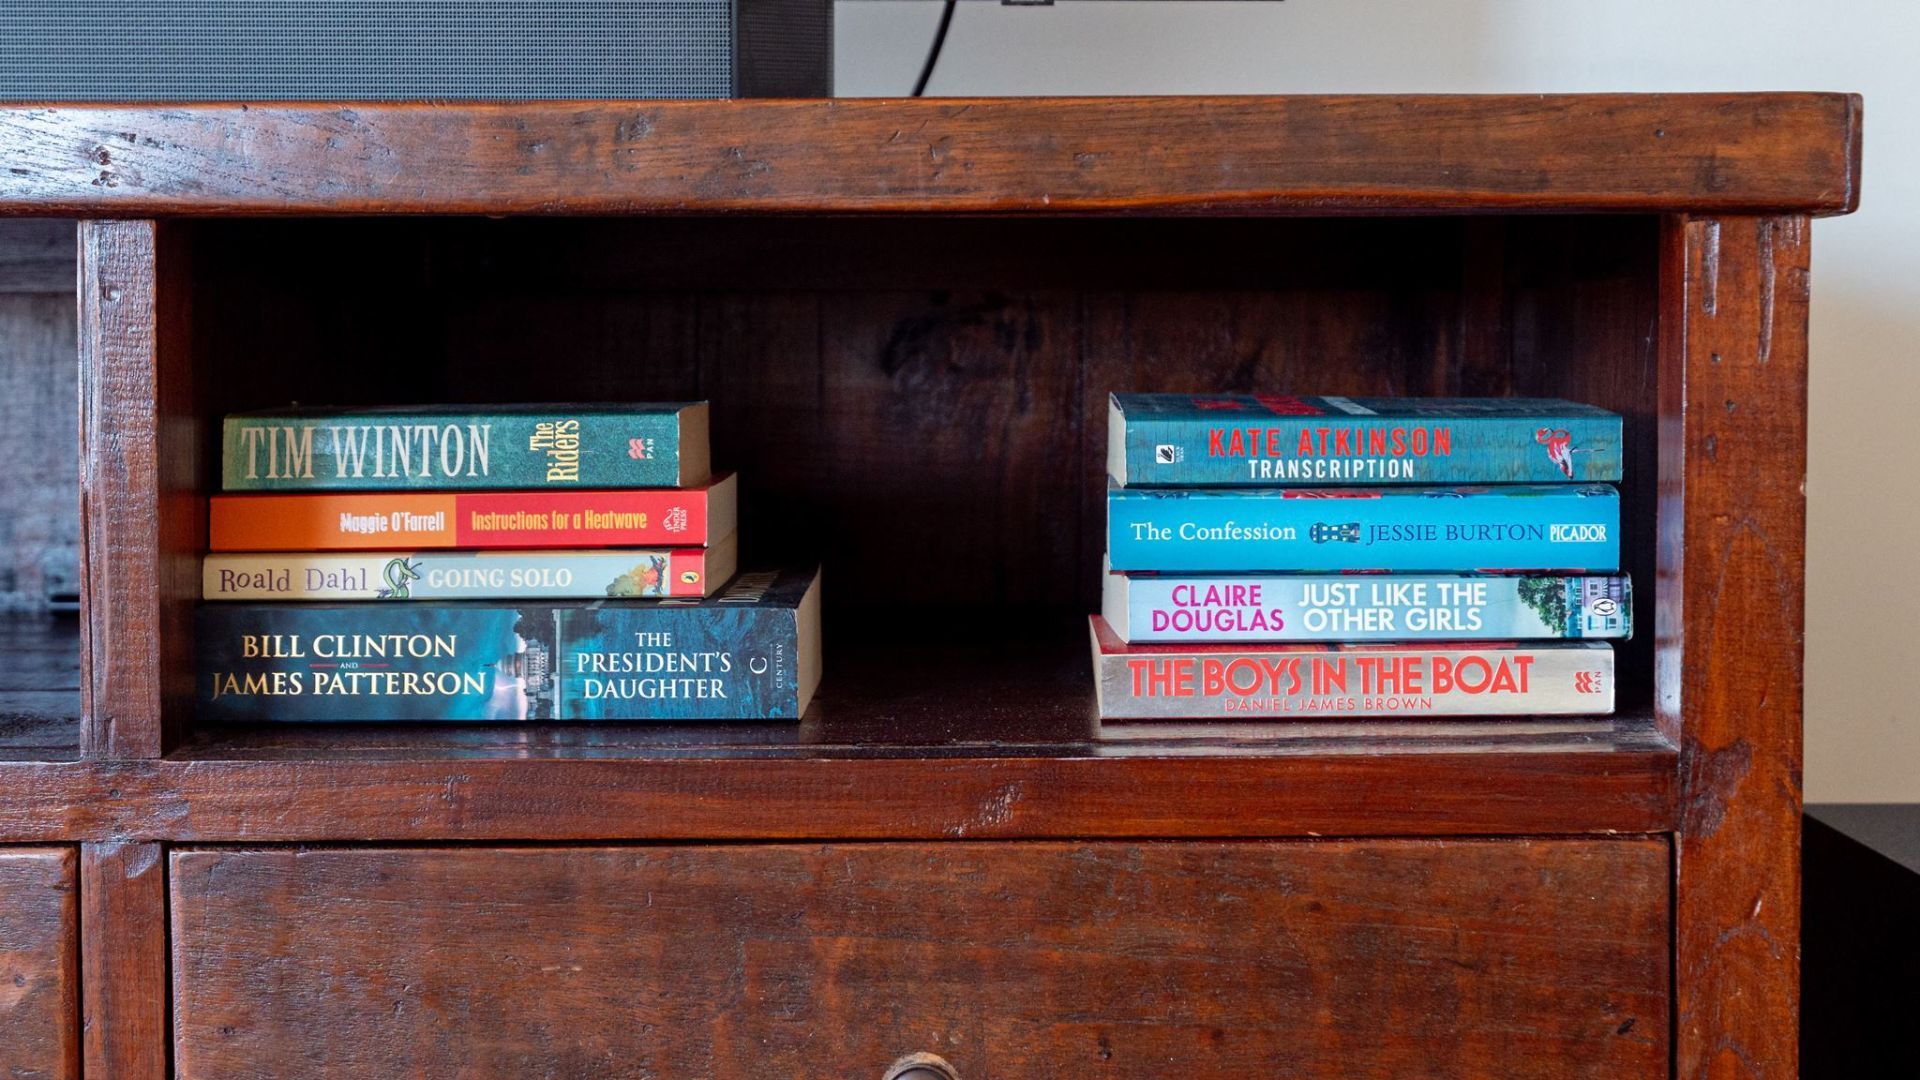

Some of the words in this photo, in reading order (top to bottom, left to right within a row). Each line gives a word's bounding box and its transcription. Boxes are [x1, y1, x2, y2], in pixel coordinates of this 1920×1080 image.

[529, 422, 554, 451] The
[1208, 428, 1281, 457] KATE
[1297, 427, 1451, 457] ATKINSON
[241, 426, 316, 479] TIM
[329, 424, 491, 478] WINTON
[547, 420, 580, 482] Riders
[646, 439, 654, 459] PAN
[1248, 459, 1414, 479] TRANSCRIPTION
[340, 512, 387, 534] Maggie
[471, 511, 548, 531] Instructions
[552, 510, 569, 529] for
[573, 513, 581, 529] a
[585, 509, 647, 529] Heatwave
[1130, 522, 1172, 541] The
[1179, 520, 1297, 541] Confession
[1366, 524, 1437, 545] JESSIE
[1445, 524, 1545, 542] BURTON
[1550, 523, 1607, 542] PICADOR
[219, 568, 291, 593] Roald
[304, 568, 368, 592] Dahl
[427, 568, 504, 588] GOING
[510, 567, 573, 588] SOLO
[1171, 584, 1262, 607] CLAIRE
[1297, 583, 1360, 607] JUST
[1372, 583, 1427, 606] LIKE
[1437, 583, 1487, 606] THE
[1152, 609, 1284, 632] DOUGLAS
[1303, 608, 1395, 632] OTHER
[1405, 607, 1482, 631] GIRLS
[242, 635, 305, 658] BILL
[313, 634, 457, 658] CLINTON
[635, 632, 671, 647] THE
[775, 642, 783, 689] CENTURY
[1127, 658, 1195, 697] THE
[1202, 657, 1302, 697] BOYS
[1311, 657, 1347, 695] IN
[1355, 657, 1422, 695] THE
[1432, 655, 1534, 694] BOAT
[212, 672, 303, 700] JAMES
[313, 672, 486, 696] PATTERSON
[584, 679, 728, 699] DAUGHTER
[1594, 671, 1602, 694] PAN
[1225, 697, 1290, 712] DANIEL
[1298, 697, 1355, 711] JAMES
[1365, 697, 1432, 710] BROWN
